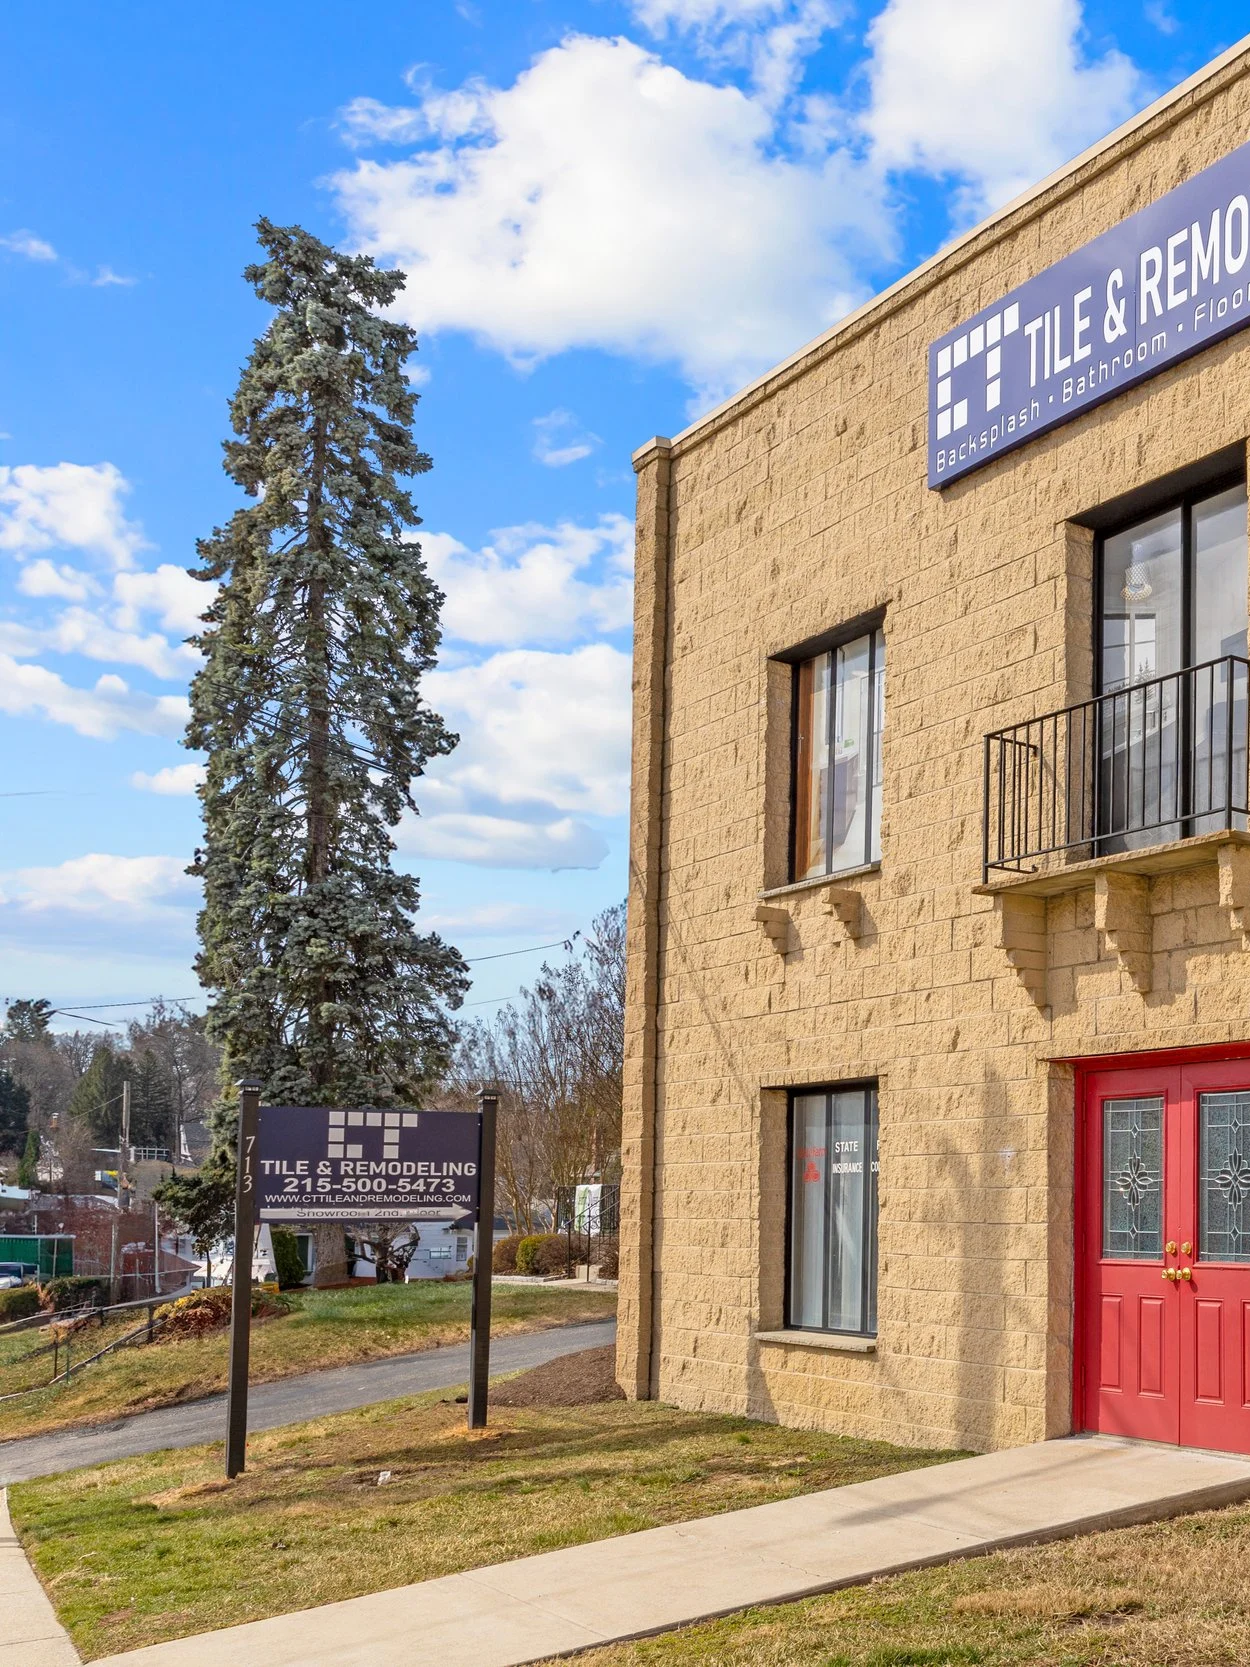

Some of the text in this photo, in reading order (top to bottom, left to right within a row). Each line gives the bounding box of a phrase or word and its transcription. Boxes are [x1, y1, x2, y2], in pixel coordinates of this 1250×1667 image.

[1024, 286, 1093, 387] TILE
[1102, 267, 1127, 345] &
[936, 398, 1040, 474] Backsplash
[1062, 330, 1167, 402] Bathroom
[834, 1141, 859, 1153] STATE
[260, 1160, 477, 1177] TILE & REMODELING
[832, 1162, 863, 1174] INSURANCE
[283, 1177, 456, 1193] 215-500-5473
[265, 1194, 471, 1204] WWW.CTTILEANDREMODELING.COM
[406, 1207, 441, 1217] oor
